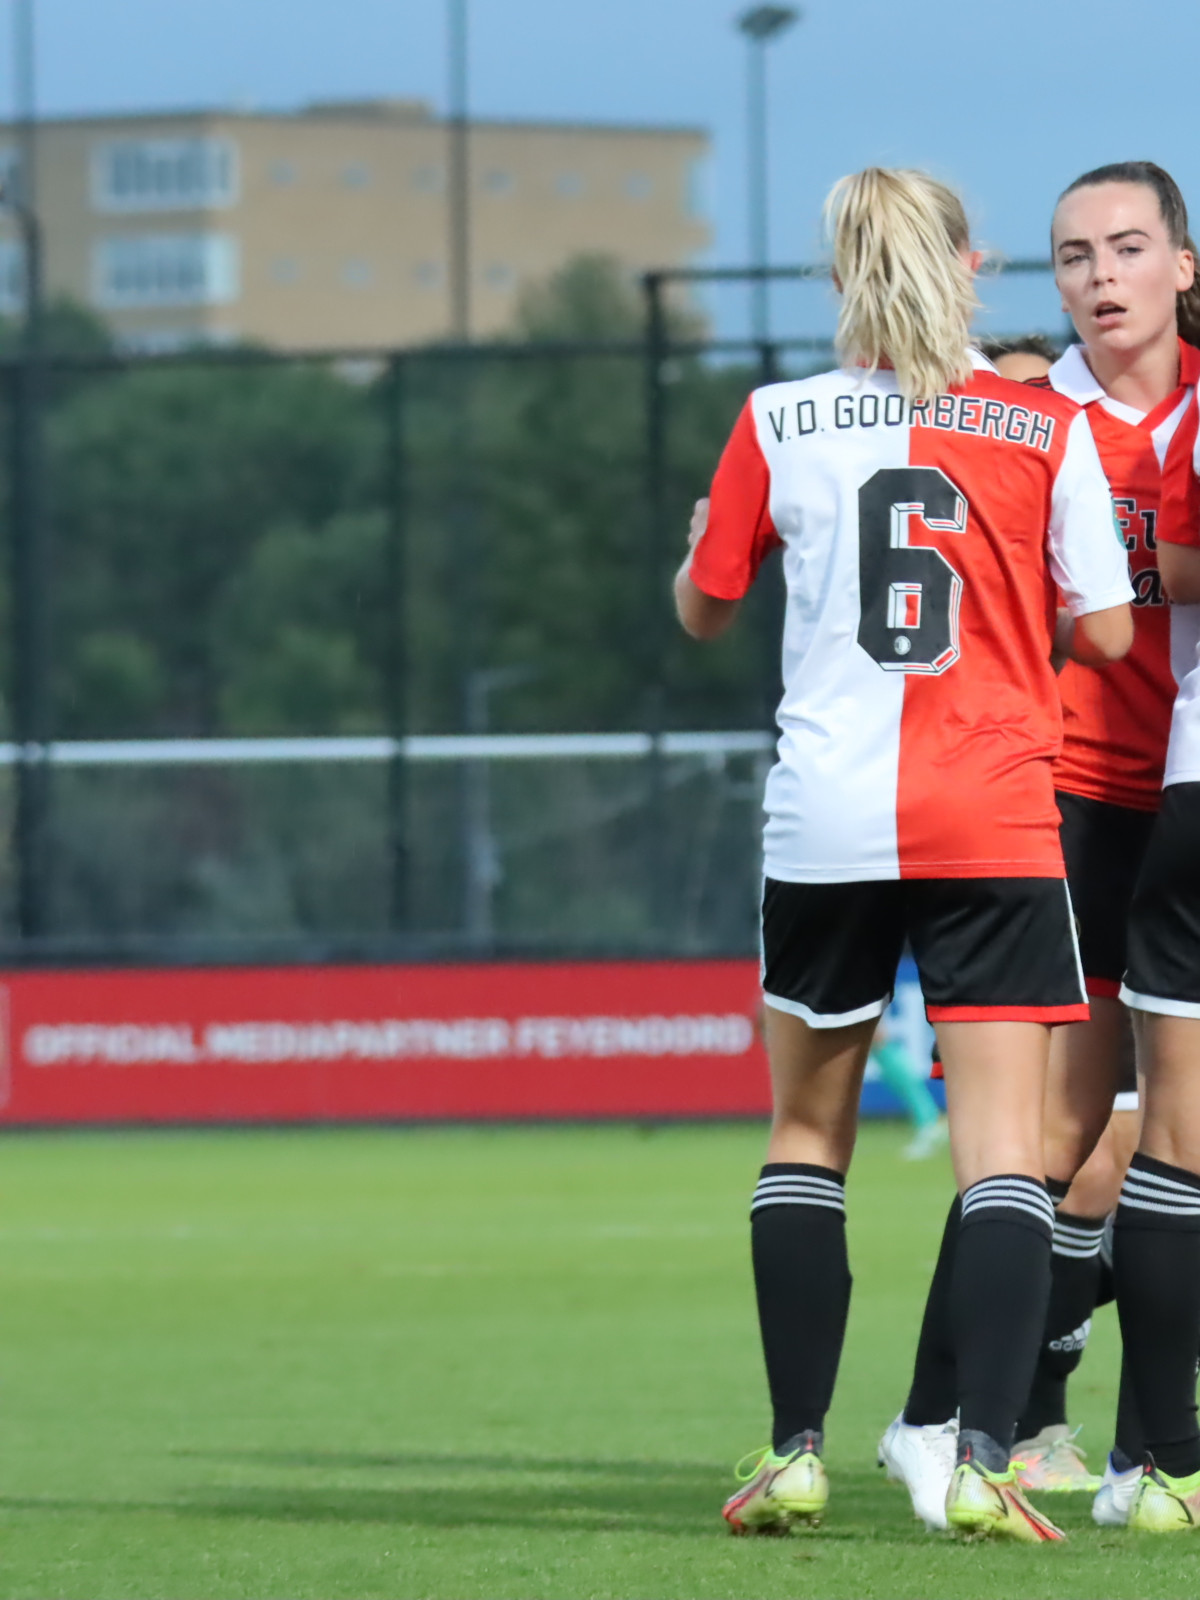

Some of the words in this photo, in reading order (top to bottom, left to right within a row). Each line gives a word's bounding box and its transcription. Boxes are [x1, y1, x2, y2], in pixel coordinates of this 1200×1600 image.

[768, 399, 825, 443] V.D.
[834, 393, 1055, 453] GOORBERGH
[857, 466, 968, 674] 6
[24, 1021, 198, 1065] OFFICIAL
[203, 1016, 509, 1062] MEDIAPARTNER
[514, 1013, 753, 1058] FEYENOORD
